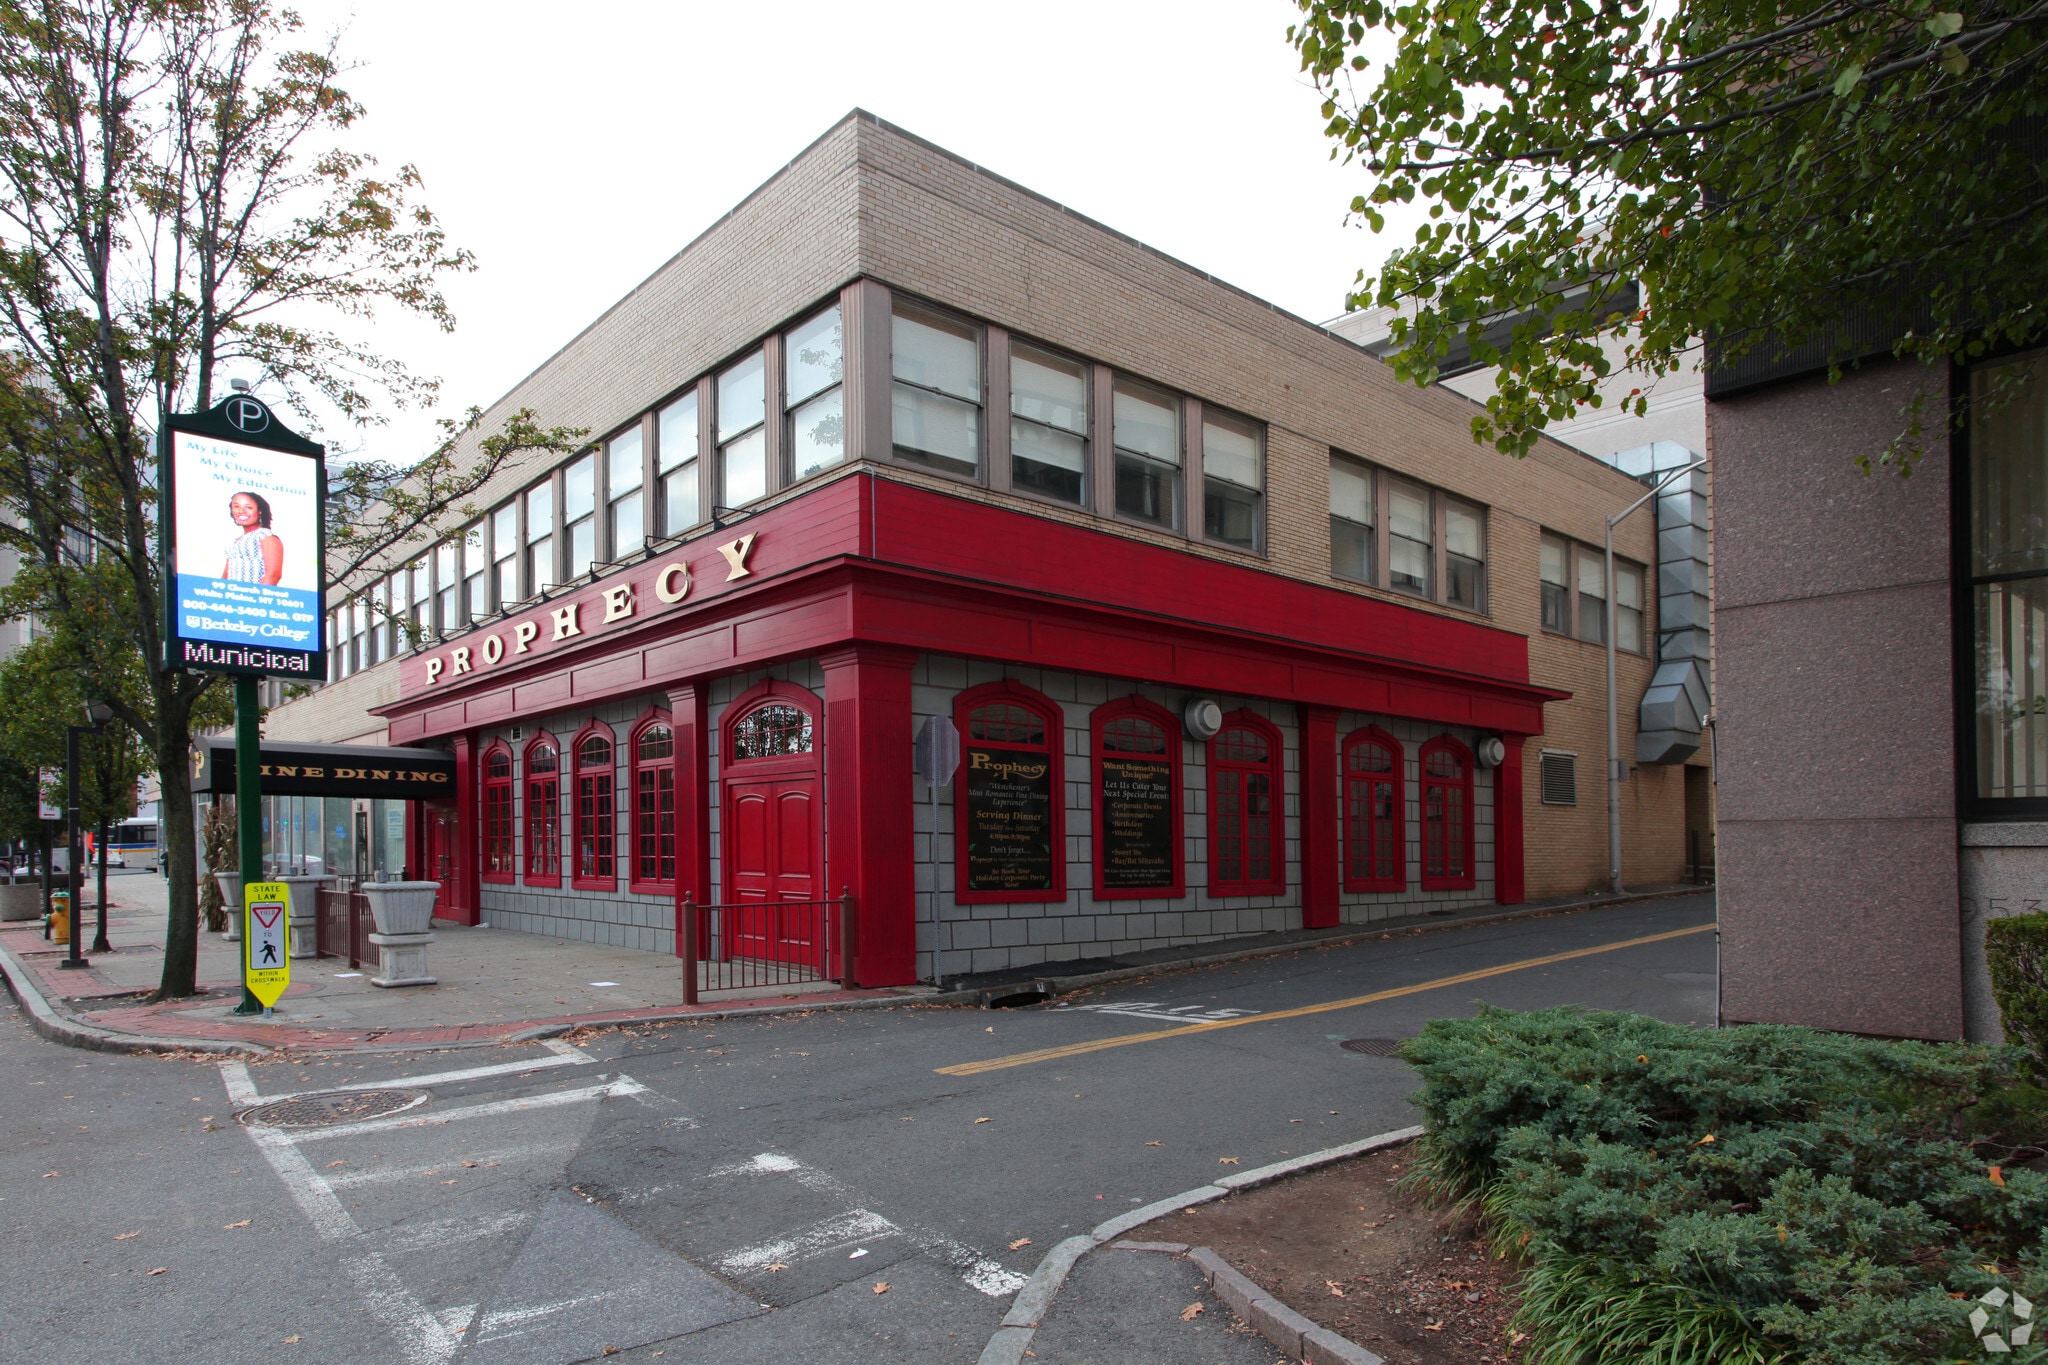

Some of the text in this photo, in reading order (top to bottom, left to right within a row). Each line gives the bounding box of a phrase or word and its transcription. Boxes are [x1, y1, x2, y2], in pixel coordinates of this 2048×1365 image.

[239, 400, 262, 428] P
[187, 442, 238, 457] My Life
[200, 457, 272, 476] My Choice
[213, 473, 306, 495] My Education
[194, 588, 223, 598] White
[259, 597, 274, 605] NY
[227, 584, 260, 594] Church
[262, 588, 290, 598] Street
[425, 531, 759, 684] PROPHECY
[201, 617, 310, 641] Berkeley College
[185, 641, 309, 671] Municipal
[233, 764, 449, 782] INE DINING
[970, 752, 1047, 780] Prophecy
[1103, 762, 1169, 774] Want Something
[1121, 771, 1153, 780] Unique?
[1120, 781, 1129, 789] Us
[1132, 782, 1150, 790] Cater
[1152, 783, 1167, 791] Your
[968, 789, 983, 797] Most
[984, 790, 1014, 798] Romantic
[1029, 792, 1048, 801] Dining
[1122, 790, 1147, 800] Special
[976, 809, 1042, 822] Serving Dinner
[978, 822, 1040, 835] Tuesday Saturday
